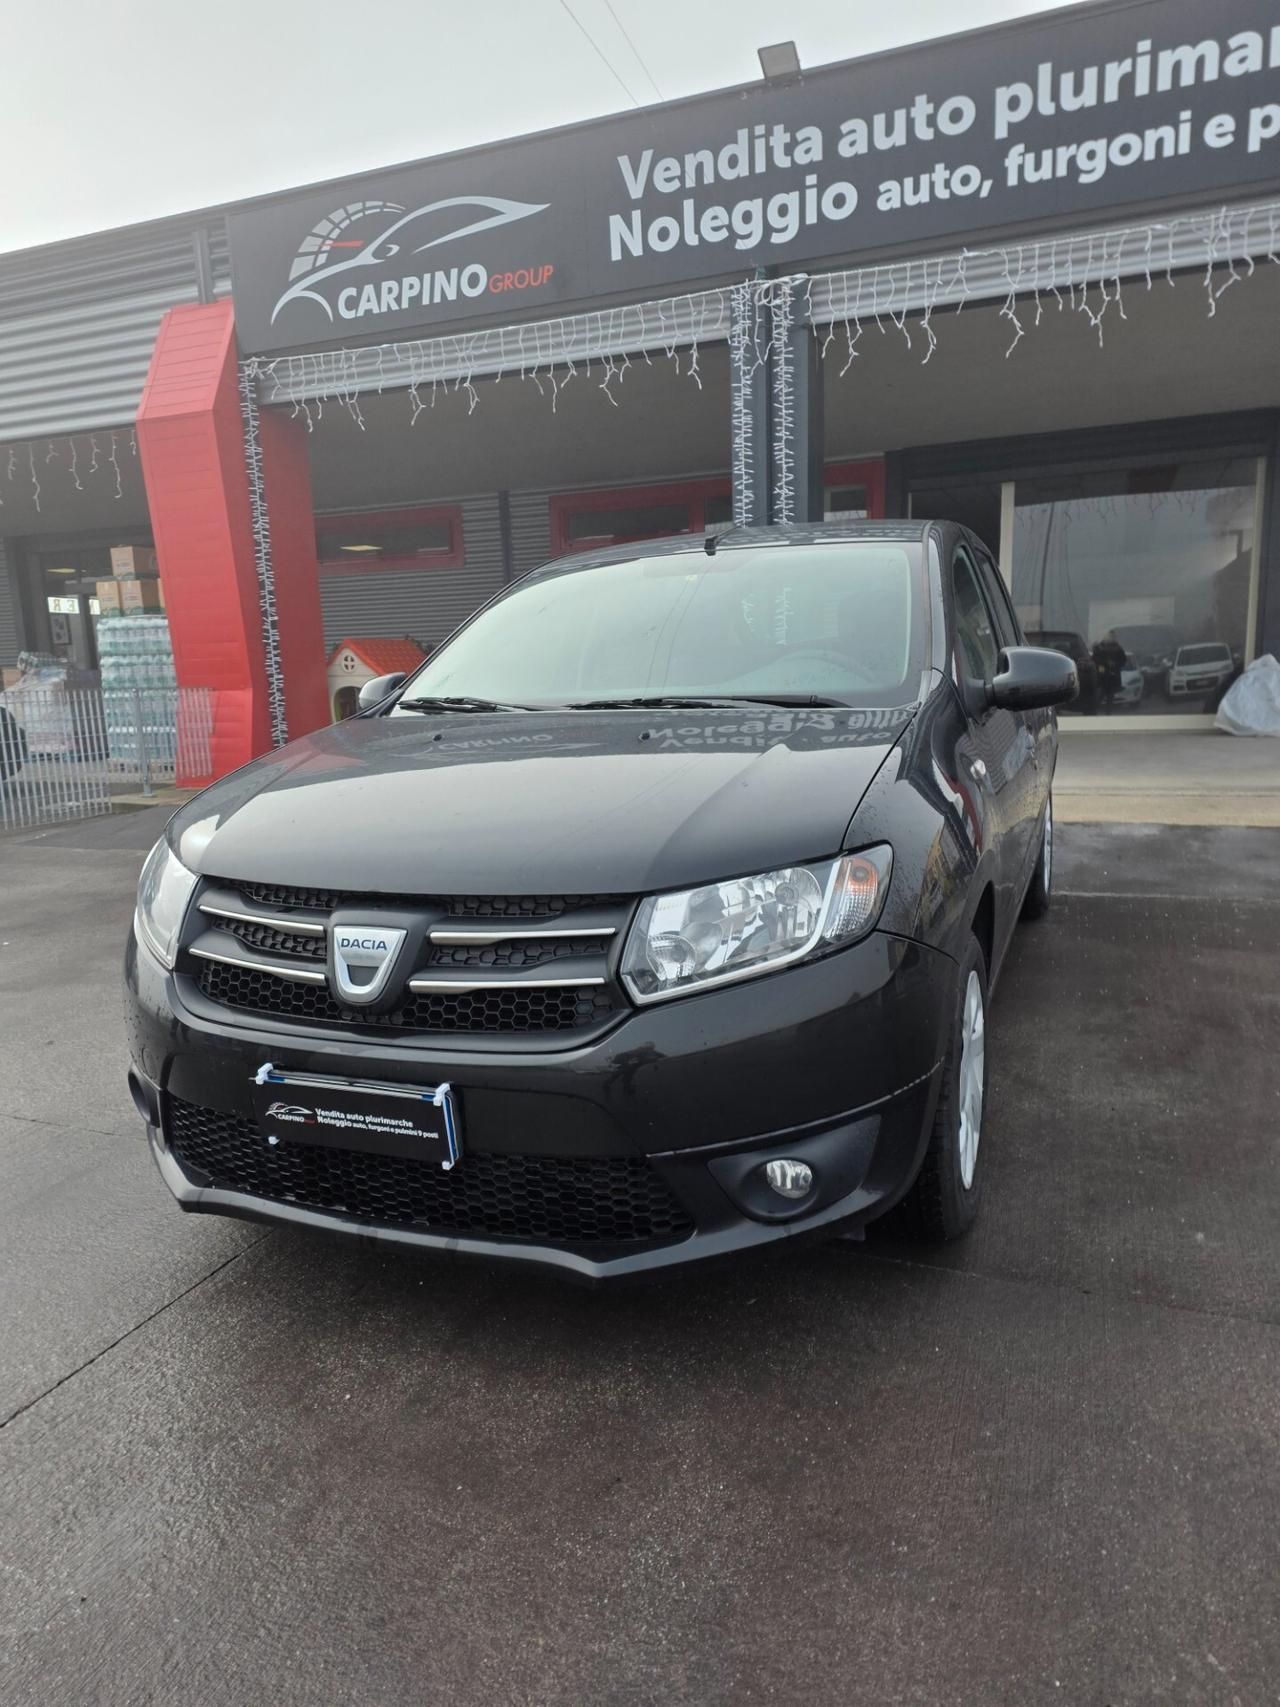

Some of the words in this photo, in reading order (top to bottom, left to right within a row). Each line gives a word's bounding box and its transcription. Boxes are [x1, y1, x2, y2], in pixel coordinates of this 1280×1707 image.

[608, 173, 858, 262] Noleggio
[876, 162, 993, 212] auto,
[1004, 109, 1192, 187] furgoni
[1203, 113, 1236, 148] e
[617, 122, 823, 200] Vendita
[838, 94, 976, 157] auto
[337, 263, 488, 320] CARPINO
[488, 265, 554, 293] GROUP
[340, 937, 387, 951] DACIA
